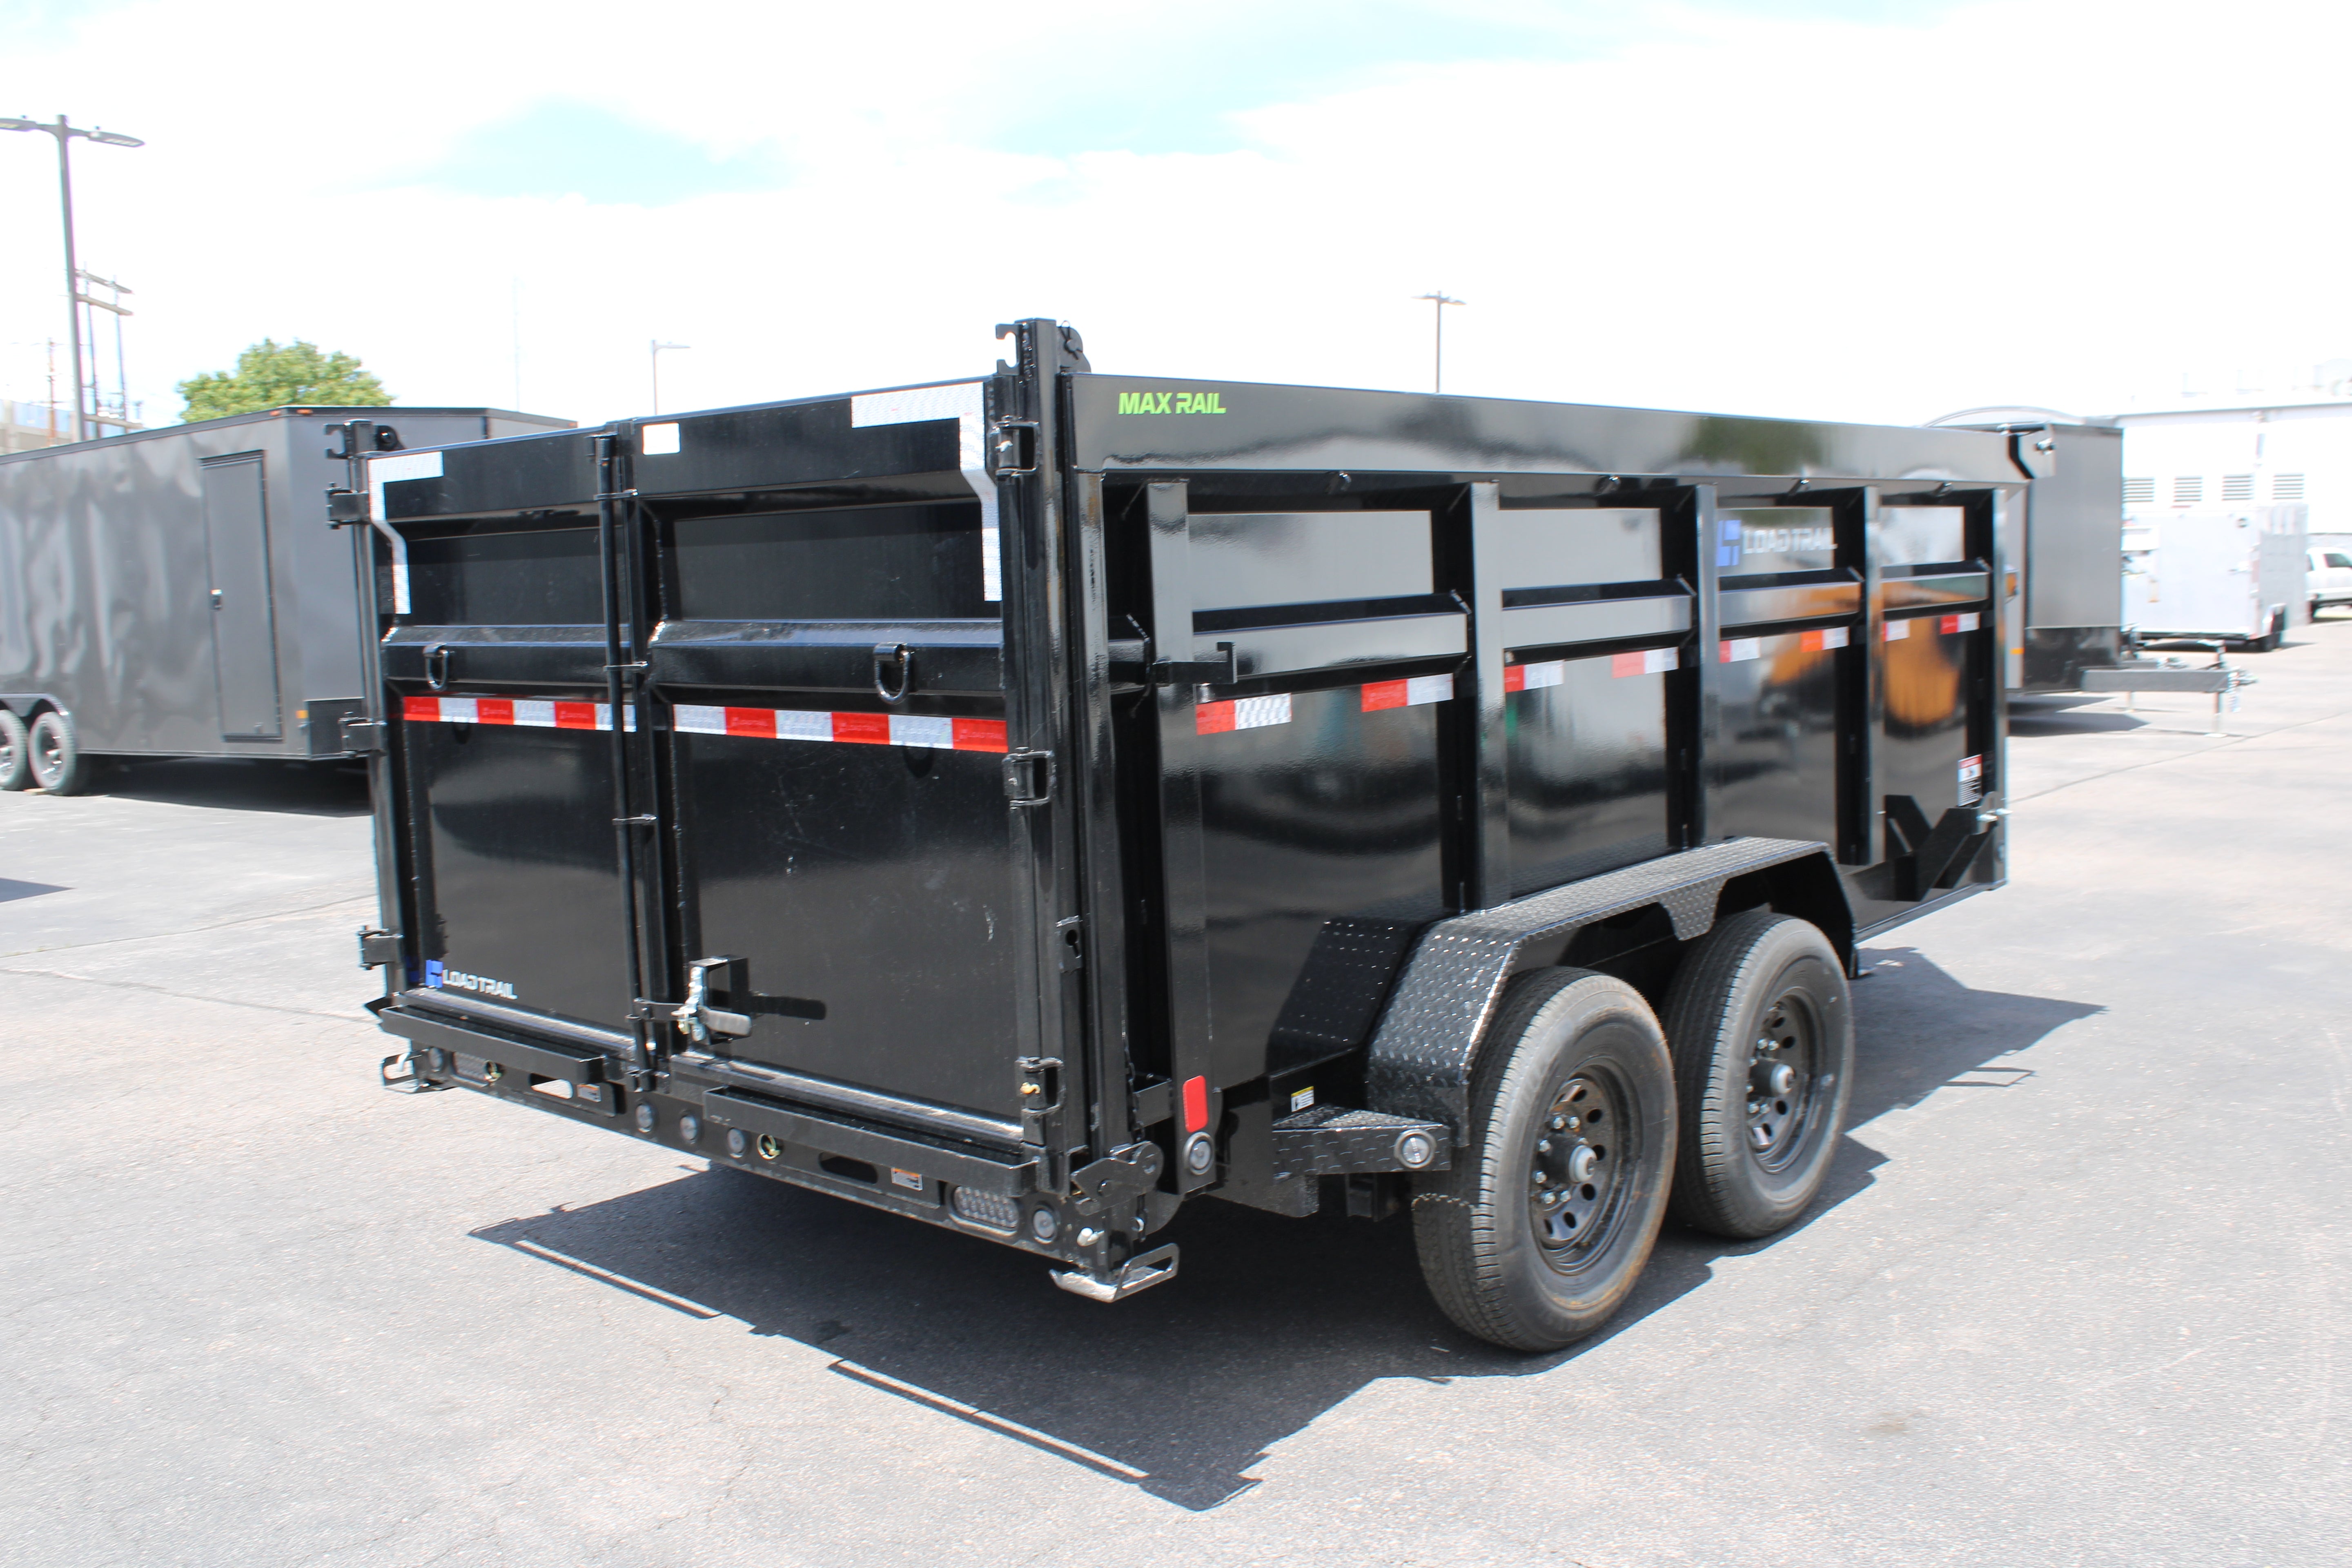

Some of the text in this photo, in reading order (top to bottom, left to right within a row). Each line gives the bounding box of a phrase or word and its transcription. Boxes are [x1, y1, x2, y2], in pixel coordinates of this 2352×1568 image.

[1118, 392, 1227, 415] MAX RAIL
[442, 969, 518, 1000] LOADTRAIL
